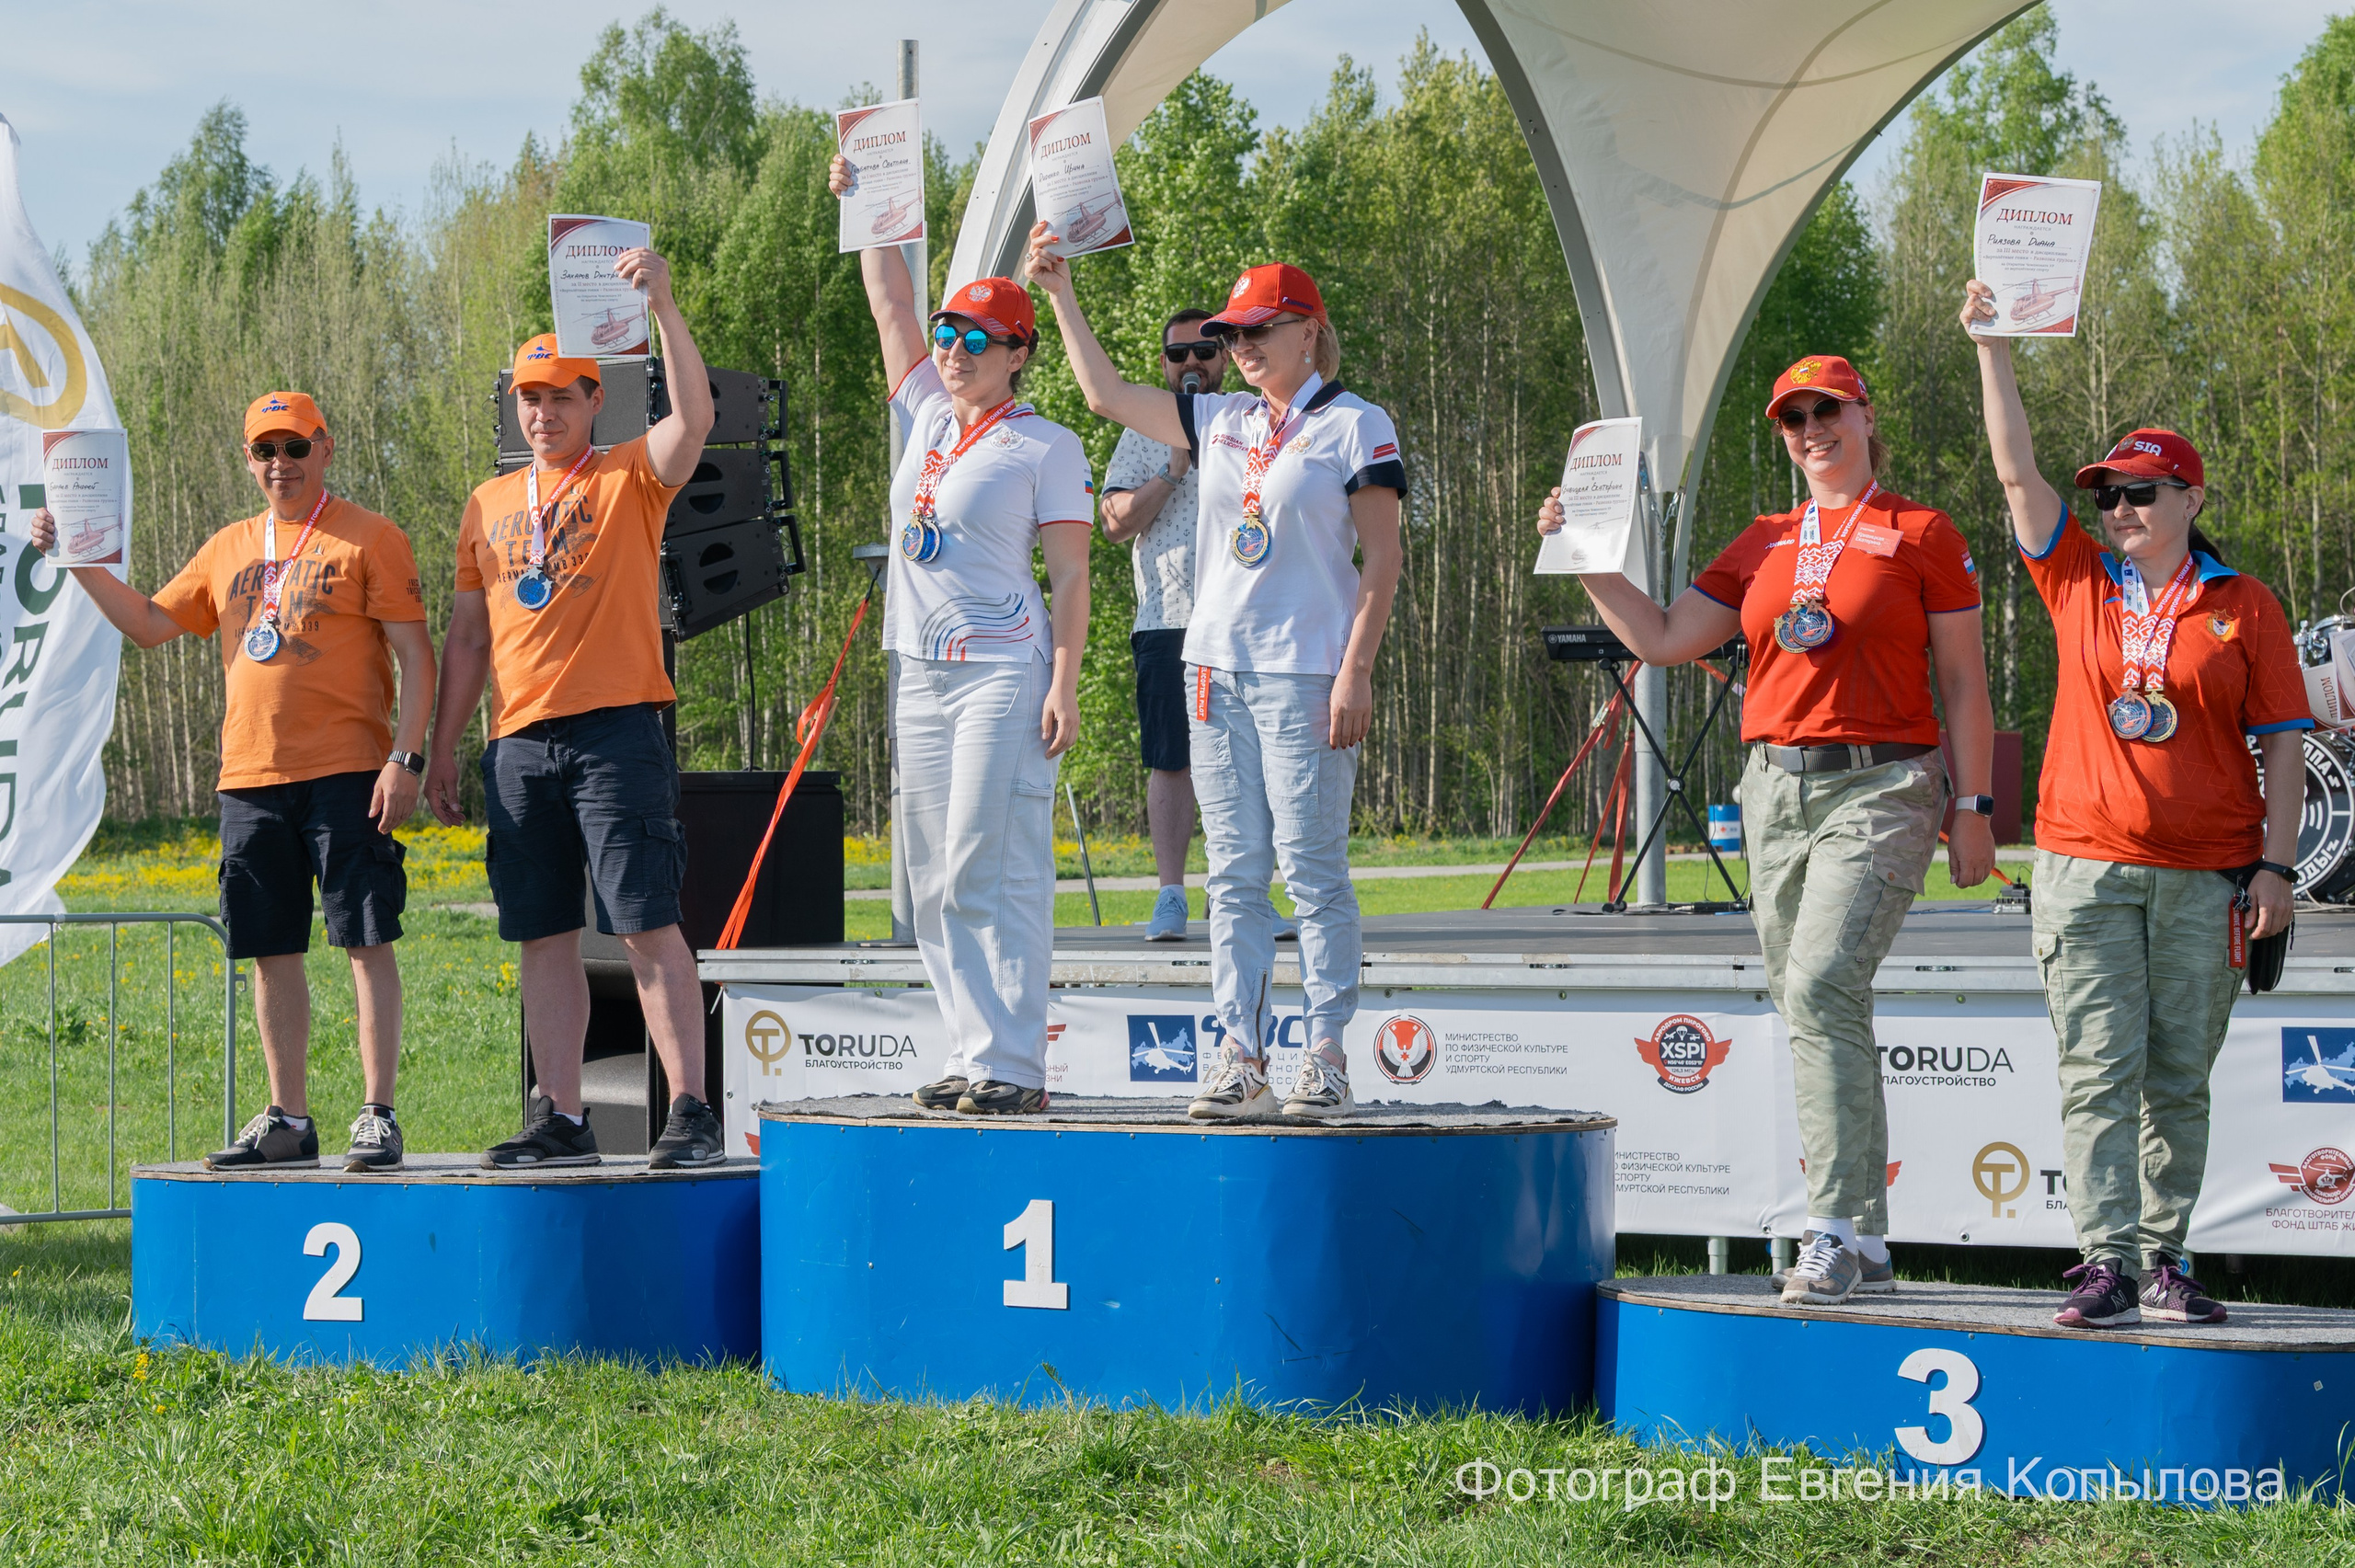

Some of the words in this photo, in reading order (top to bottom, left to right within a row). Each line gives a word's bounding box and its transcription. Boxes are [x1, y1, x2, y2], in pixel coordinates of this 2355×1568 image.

[853, 131, 907, 154] ДИПЛОМ
[1040, 132, 1092, 160] ДИПЛОМ
[1996, 208, 2074, 225] ДИПЛОМ
[2028, 236, 2056, 247] Диана
[566, 246, 631, 259] ДИПЛОМ
[560, 269, 590, 280] Захаров
[593, 269, 619, 280] Дмитри
[527, 352, 555, 361] ФВС
[261, 405, 290, 414] ФВС
[956, 419, 989, 452] ВЕРТОЛЕТНЫЕ
[987, 406, 1005, 423] ГОНКИ
[1221, 434, 1244, 445] RUSSIAN
[1218, 440, 1249, 452] HELICOPTER
[52, 458, 109, 471] ДИПЛОМ
[1569, 453, 1623, 472] ДИПЛОМ
[551, 470, 577, 500] ВЕРТОЛЕТНЫЕ
[1841, 504, 1864, 537] ВЕРТОЛЕТНЫЕ
[291, 521, 315, 556] ВЕРТОЛЕТНЫЕ
[311, 502, 325, 521] ГОНКИ
[506, 527, 569, 567] TEM
[1855, 536, 1881, 546] Екатерина
[229, 559, 336, 602] AERATIC
[2154, 581, 2179, 613] ВЕРТОЛЕТНЫЕ
[2177, 564, 2190, 583] ГОНКИ
[301, 621, 319, 632] 339
[1557, 634, 1586, 643] YAMAHA
[1199, 666, 1208, 698] ELICOPTER
[2234, 945, 2242, 964] FLIGHT
[1655, 1018, 1683, 1043] АЭРОДРОМ
[1683, 1018, 1712, 1043] ПИРОГОВО
[1445, 1033, 1519, 1042] МИНИСТРЕСТВО
[798, 1034, 917, 1058] TORUDA
[1445, 1044, 1459, 1052] ПО
[1461, 1042, 1522, 1053] ФИЗИЧЕСКОЙ
[1524, 1045, 1568, 1054] КУЛЬТУРЕ
[1660, 1042, 1706, 1059] XSPI
[805, 1059, 903, 1070] БЛАГОУСТРОЙСТВО
[1454, 1055, 1490, 1063] СПОРТУ
[1445, 1064, 1505, 1075] УДМУРТСКОЙ
[1507, 1066, 1568, 1075] РЕСПУБЛИКИ
[1669, 1074, 1701, 1083] ИЖЕВСК
[1882, 1075, 1996, 1087] ЛАГОУСТРОЙСТВО
[1663, 1082, 1684, 1092] ДОСААФ
[1684, 1082, 1704, 1092] РОССИИ
[1614, 1151, 1680, 1161] ИНИСТРЕСТВО
[1621, 1162, 1683, 1173] ФИЗИЧЕСКОЙ
[1685, 1164, 1731, 1173] КУЛЬТУРЕ
[1614, 1173, 1650, 1182] СПОРТУ
[1615, 1184, 1666, 1194] МУРТСКОЙ
[1668, 1185, 1729, 1196] РЕСПУБЛИКИ
[2272, 1219, 2305, 1230] ФОНД
[2308, 1221, 2338, 1230] ШТАБ
[1004, 1199, 1067, 1309] 1
[303, 1222, 362, 1321] 2
[1894, 1348, 1983, 1464] 3
